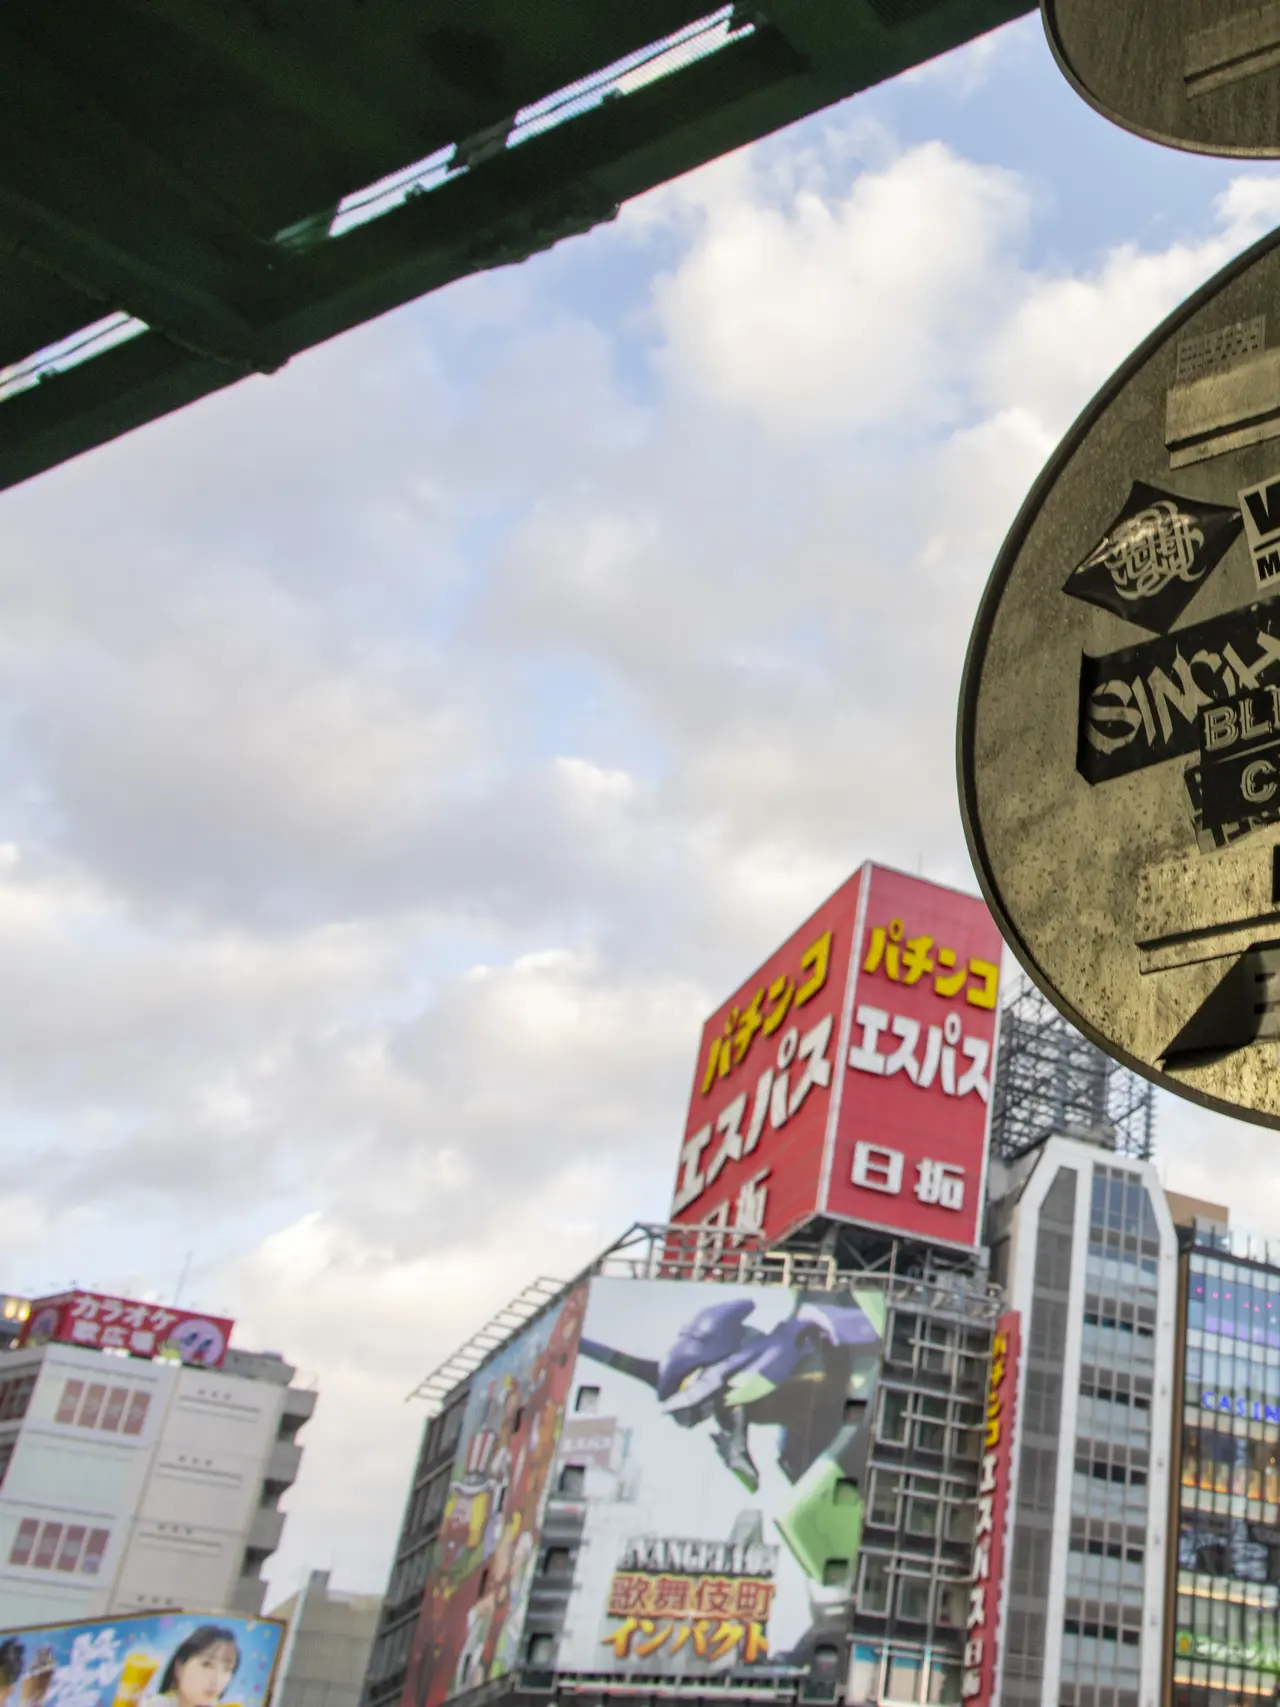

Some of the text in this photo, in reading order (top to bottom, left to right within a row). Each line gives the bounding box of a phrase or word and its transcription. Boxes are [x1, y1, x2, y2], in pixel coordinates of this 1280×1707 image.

[863, 917, 999, 1010] パチンコ
[702, 930, 833, 1094] パチンコ
[847, 1004, 990, 1103] エスパス
[671, 1013, 834, 1217] エスパス
[850, 1140, 966, 1211] 日拓
[71, 1295, 178, 1331] カラオケ
[609, 1574, 775, 1616] 歌舞伎町
[601, 1615, 769, 1664] インパクト
